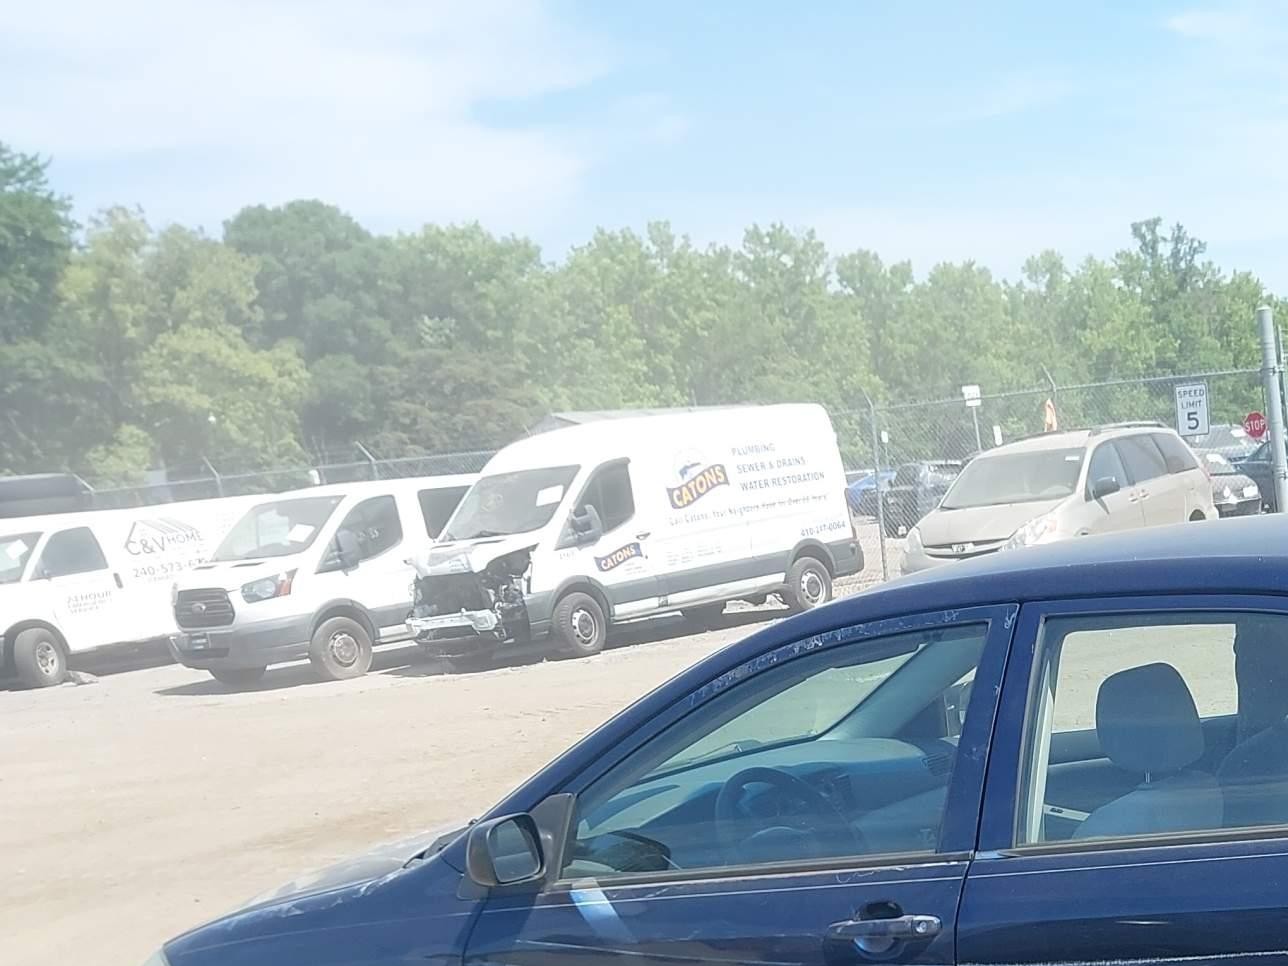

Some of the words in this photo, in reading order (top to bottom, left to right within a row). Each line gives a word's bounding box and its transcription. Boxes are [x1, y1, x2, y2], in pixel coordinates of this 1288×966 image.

[1177, 389, 1205, 399] SPEED
[1181, 400, 1202, 410] LIMIT
[1187, 411, 1200, 430] 5
[1245, 419, 1265, 432] STOP
[731, 441, 776, 457] PLUMBING
[736, 459, 767, 475] SEWER
[776, 456, 807, 470] DRAINS
[672, 465, 726, 507] CATONS
[740, 477, 770, 492] WATER
[770, 471, 825, 488] RESTORATION
[601, 545, 635, 571] CATONS
